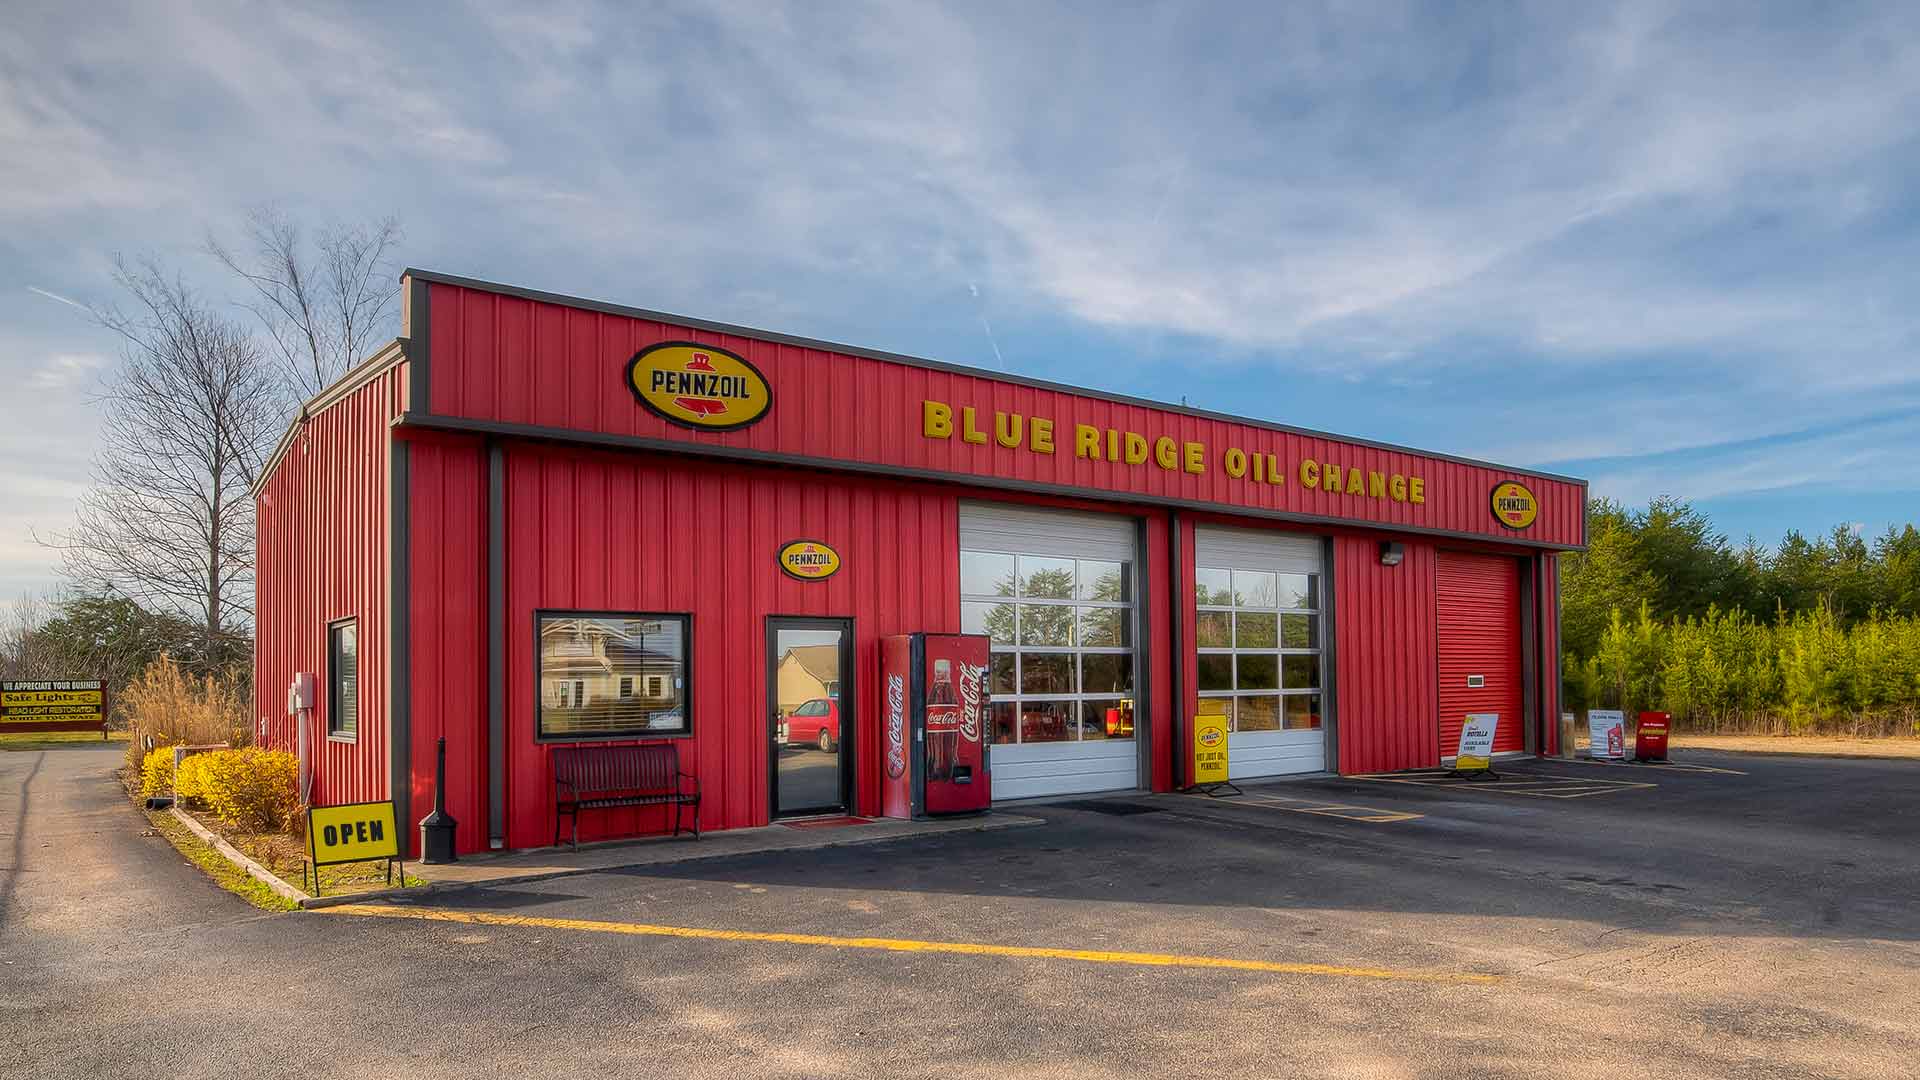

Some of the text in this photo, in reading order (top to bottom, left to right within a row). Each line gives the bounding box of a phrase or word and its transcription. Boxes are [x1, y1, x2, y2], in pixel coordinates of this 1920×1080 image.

[651, 369, 751, 399] PENNZOIL
[923, 400, 1425, 504] BLUE RIDGE OIL CHANGE
[1498, 498, 1531, 511] PENNZOIL
[788, 553, 832, 566] PENNZOIL
[3, 681, 100, 690] WE APPRECIATE YOUR BUSINESS
[5, 694, 32, 702] Safe
[36, 693, 74, 702] Lights
[49, 705, 96, 714] RESTORATION
[323, 820, 384, 846] OPEN
